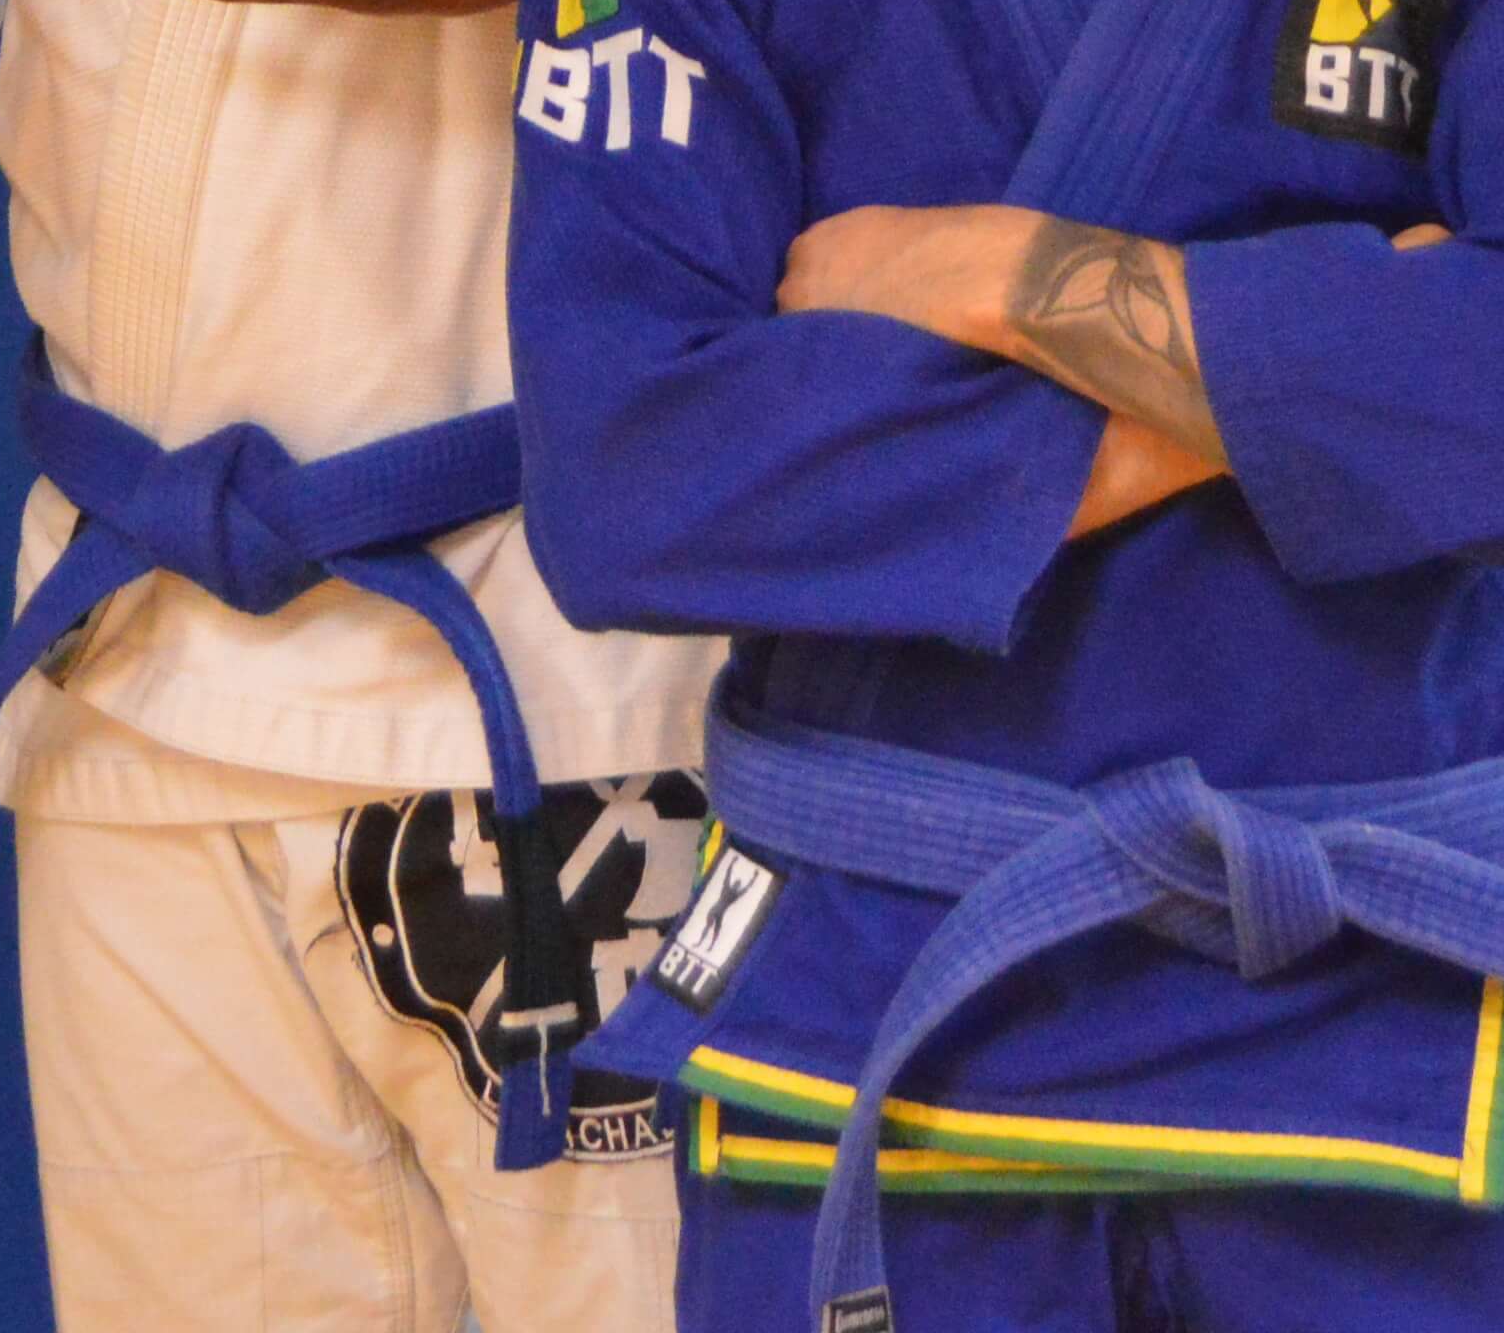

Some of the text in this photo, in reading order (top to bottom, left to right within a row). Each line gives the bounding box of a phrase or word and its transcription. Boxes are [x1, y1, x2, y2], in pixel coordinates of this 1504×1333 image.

[518, 27, 707, 151] BTT
[1304, 42, 1420, 126] BTT
[657, 941, 724, 996] BTT
[566, 1112, 675, 1151] CHA
